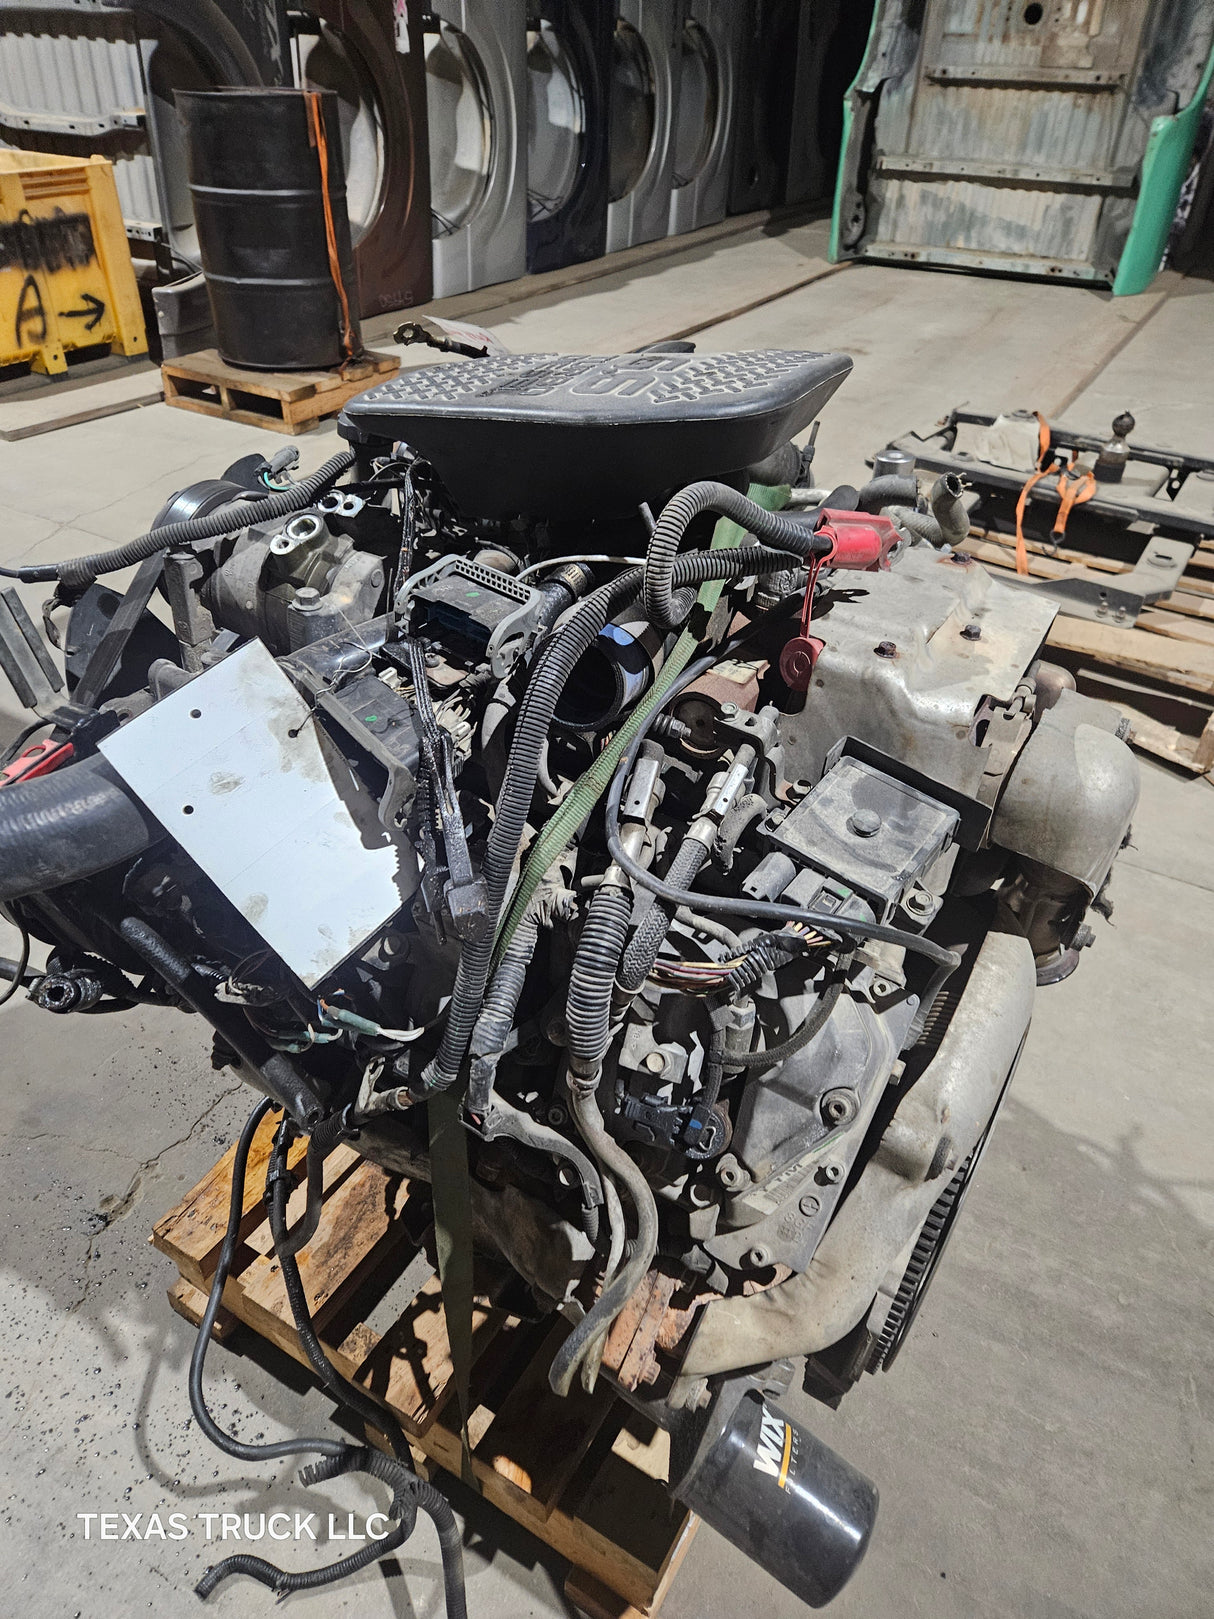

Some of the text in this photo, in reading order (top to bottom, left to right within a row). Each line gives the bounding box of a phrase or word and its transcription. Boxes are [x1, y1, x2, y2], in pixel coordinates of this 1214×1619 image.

[15, 273, 47, 348] A
[753, 1403, 785, 1477] WIX
[785, 1427, 799, 1495] FILTERS
